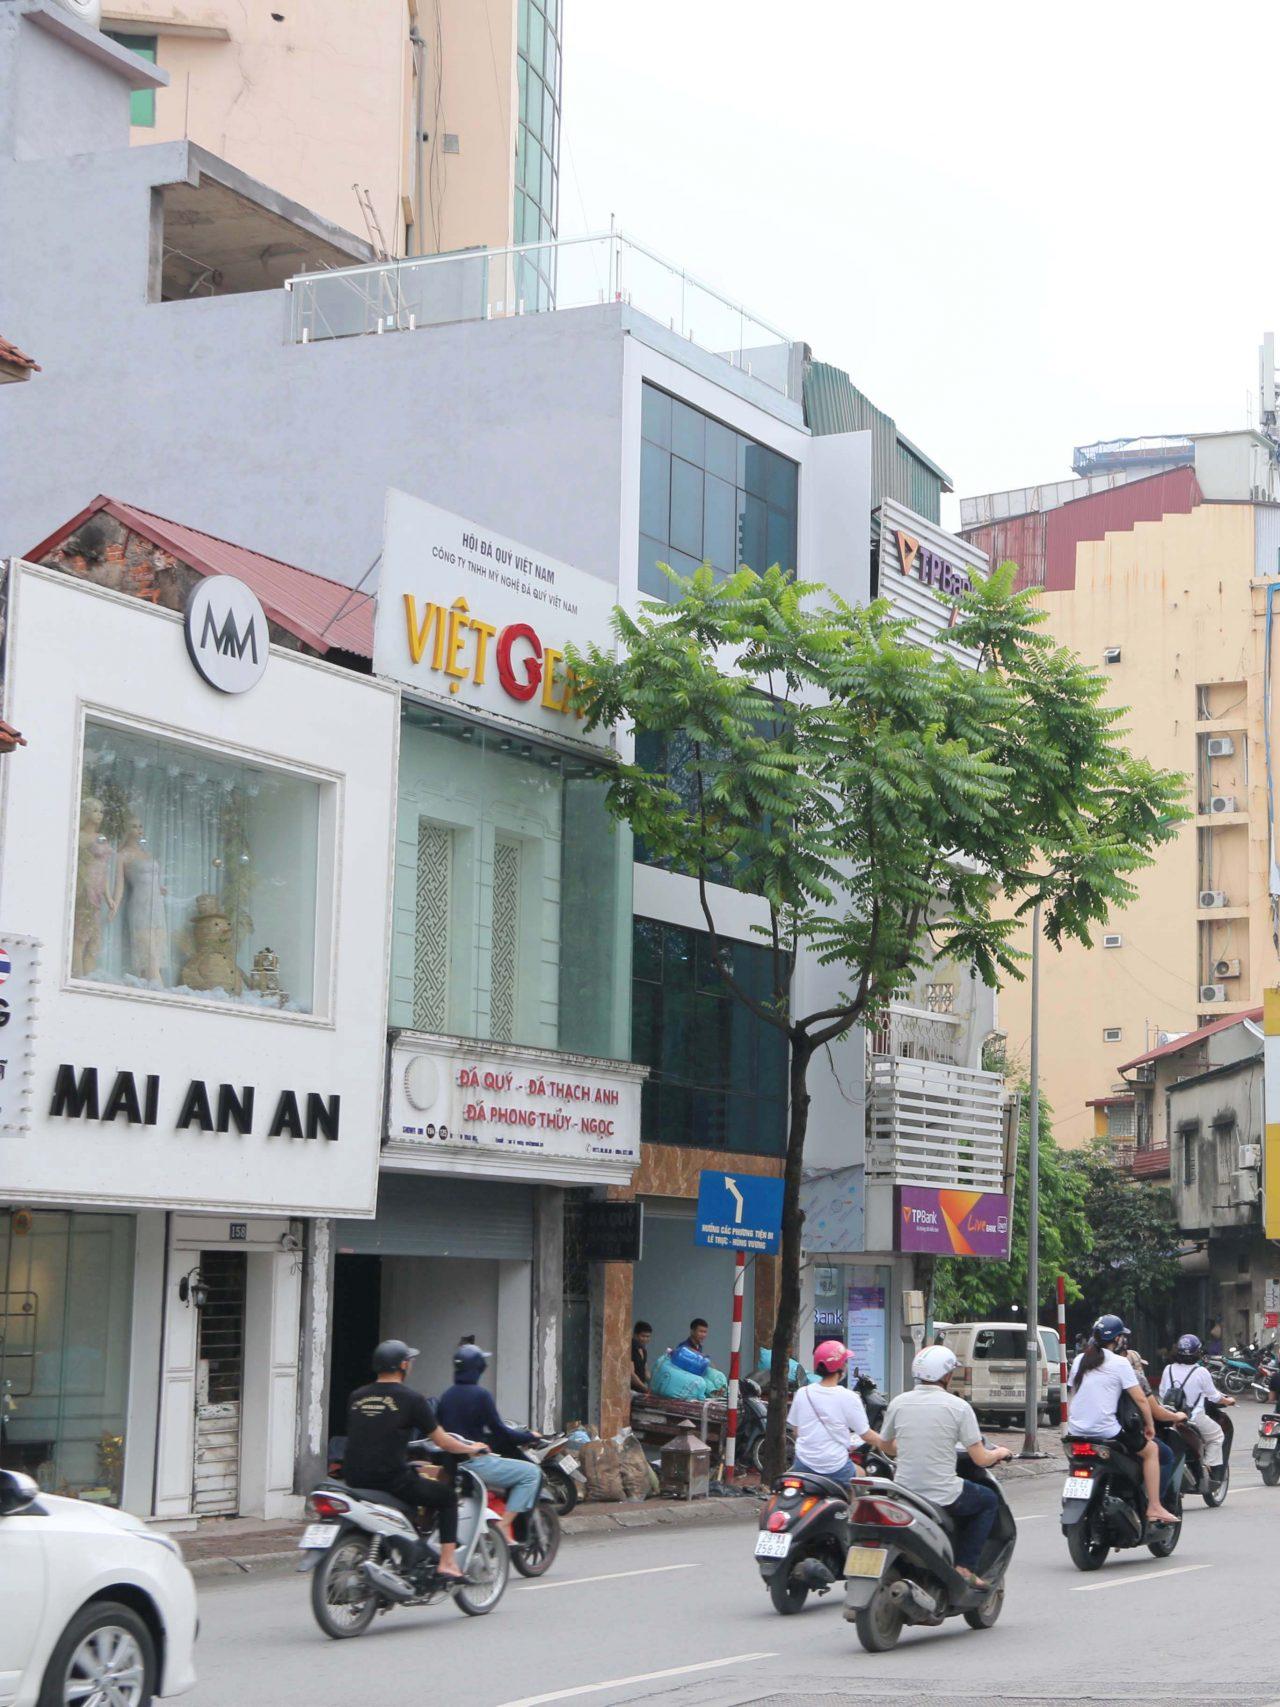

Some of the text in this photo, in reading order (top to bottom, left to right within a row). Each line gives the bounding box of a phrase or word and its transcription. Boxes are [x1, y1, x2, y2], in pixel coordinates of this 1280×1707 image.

[432, 545, 456, 564] CÔNG
[457, 556, 467, 568] TY
[468, 560, 487, 578] TNHH
[562, 600, 578, 615] NAM
[480, 540, 493, 558] ĐÁ
[495, 547, 514, 567] QUÝ
[515, 556, 533, 575] VIỆT
[535, 564, 555, 584] NAM
[919, 545, 978, 600] TPBan
[403, 593, 497, 694] VIỆT
[49, 1064, 160, 1125] MAI
[176, 1080, 255, 1135] AN
[267, 1090, 341, 1141] AN
[459, 1066, 480, 1088] ĐÁ
[483, 1071, 514, 1092] QUÝ
[528, 1075, 546, 1096] ĐÁ
[550, 1081, 591, 1104] THẠCH
[594, 1087, 619, 1106] ANH
[466, 1100, 486, 1121] ĐÁ
[490, 1106, 537, 1128] PHONG
[538, 1107, 572, 1131] THỦY
[581, 1117, 615, 1140] NGỌC
[231, 1225, 247, 1239] 158
[912, 1209, 938, 1224] TPBank
